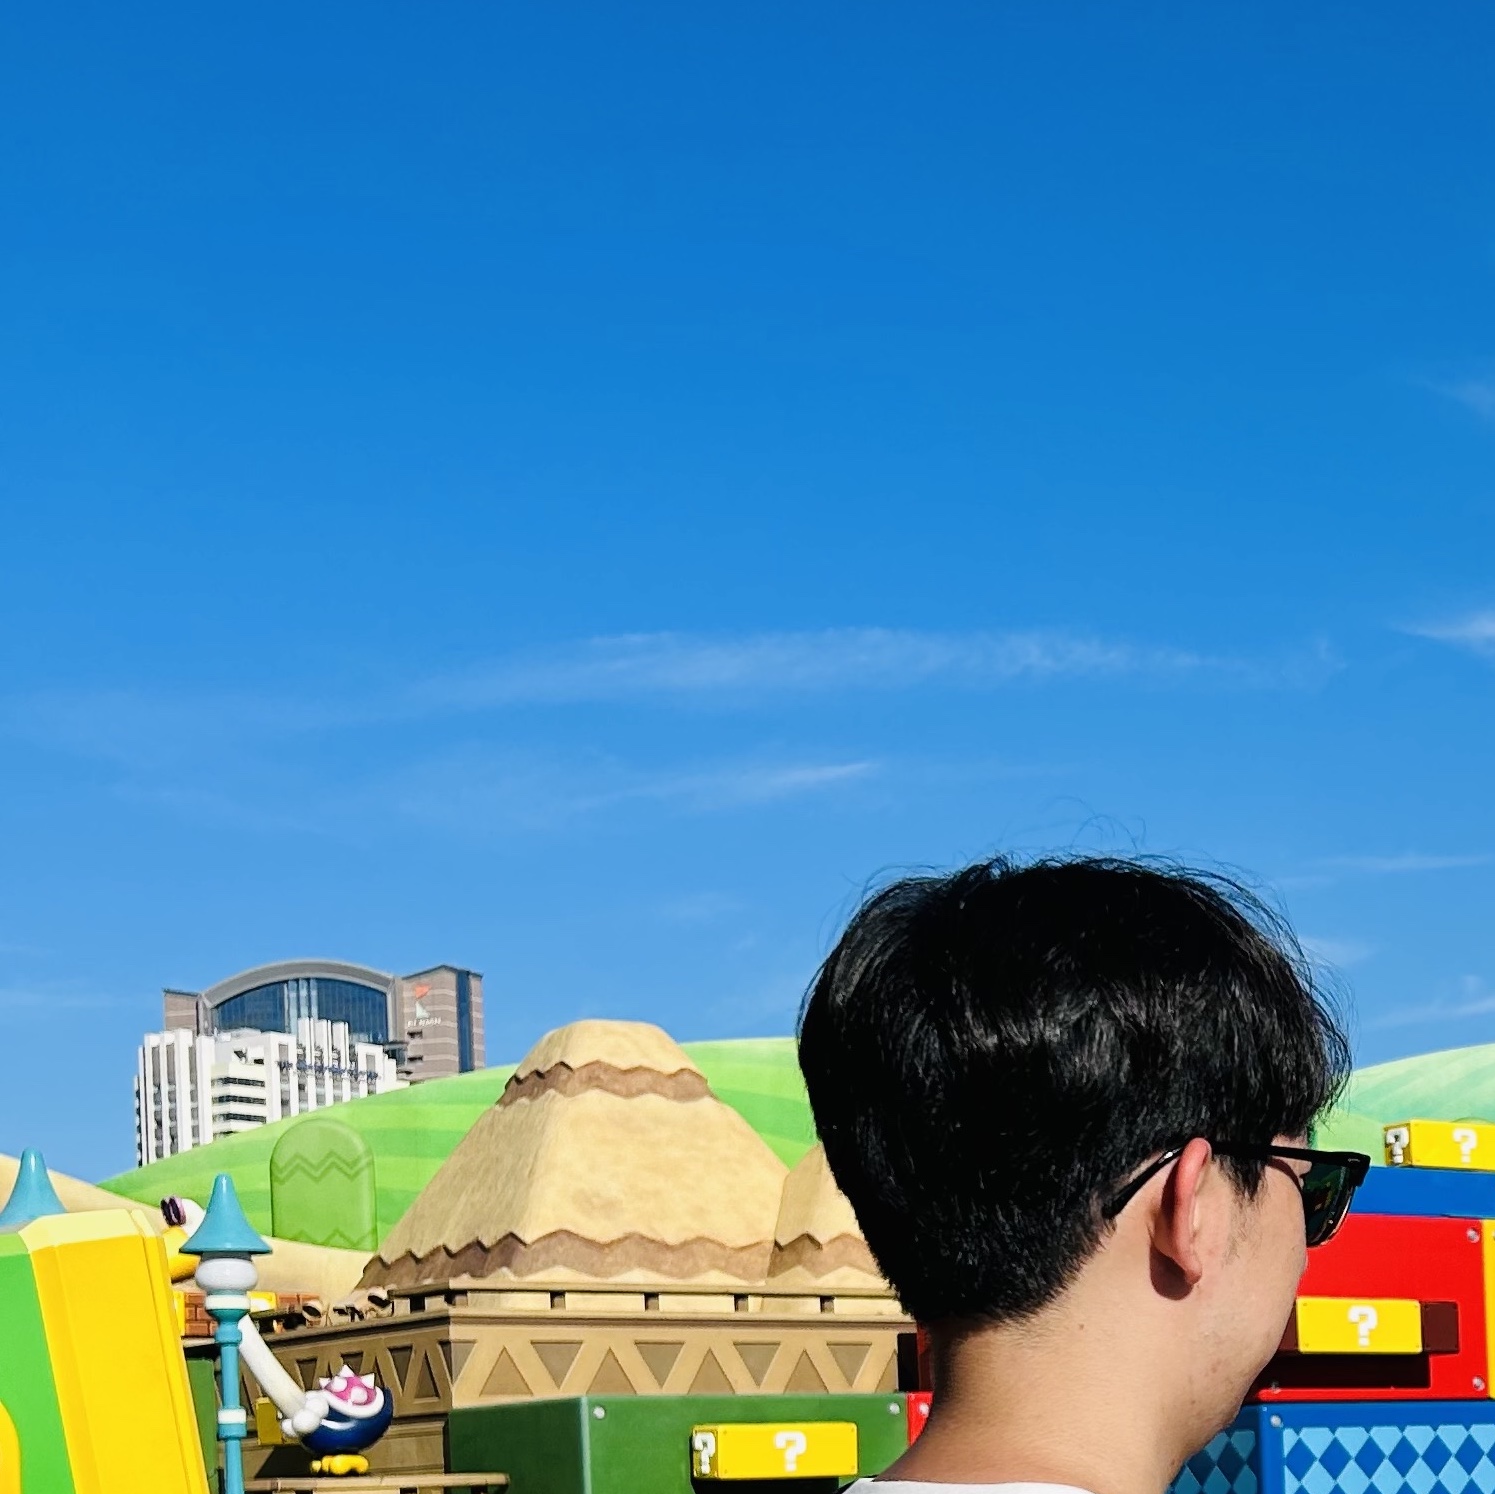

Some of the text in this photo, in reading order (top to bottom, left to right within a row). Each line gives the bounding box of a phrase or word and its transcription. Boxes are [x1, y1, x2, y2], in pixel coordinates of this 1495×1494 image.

[1453, 1128, 1478, 1164] ?
[1348, 1305, 1378, 1347] ?
[773, 1431, 807, 1472] ?
